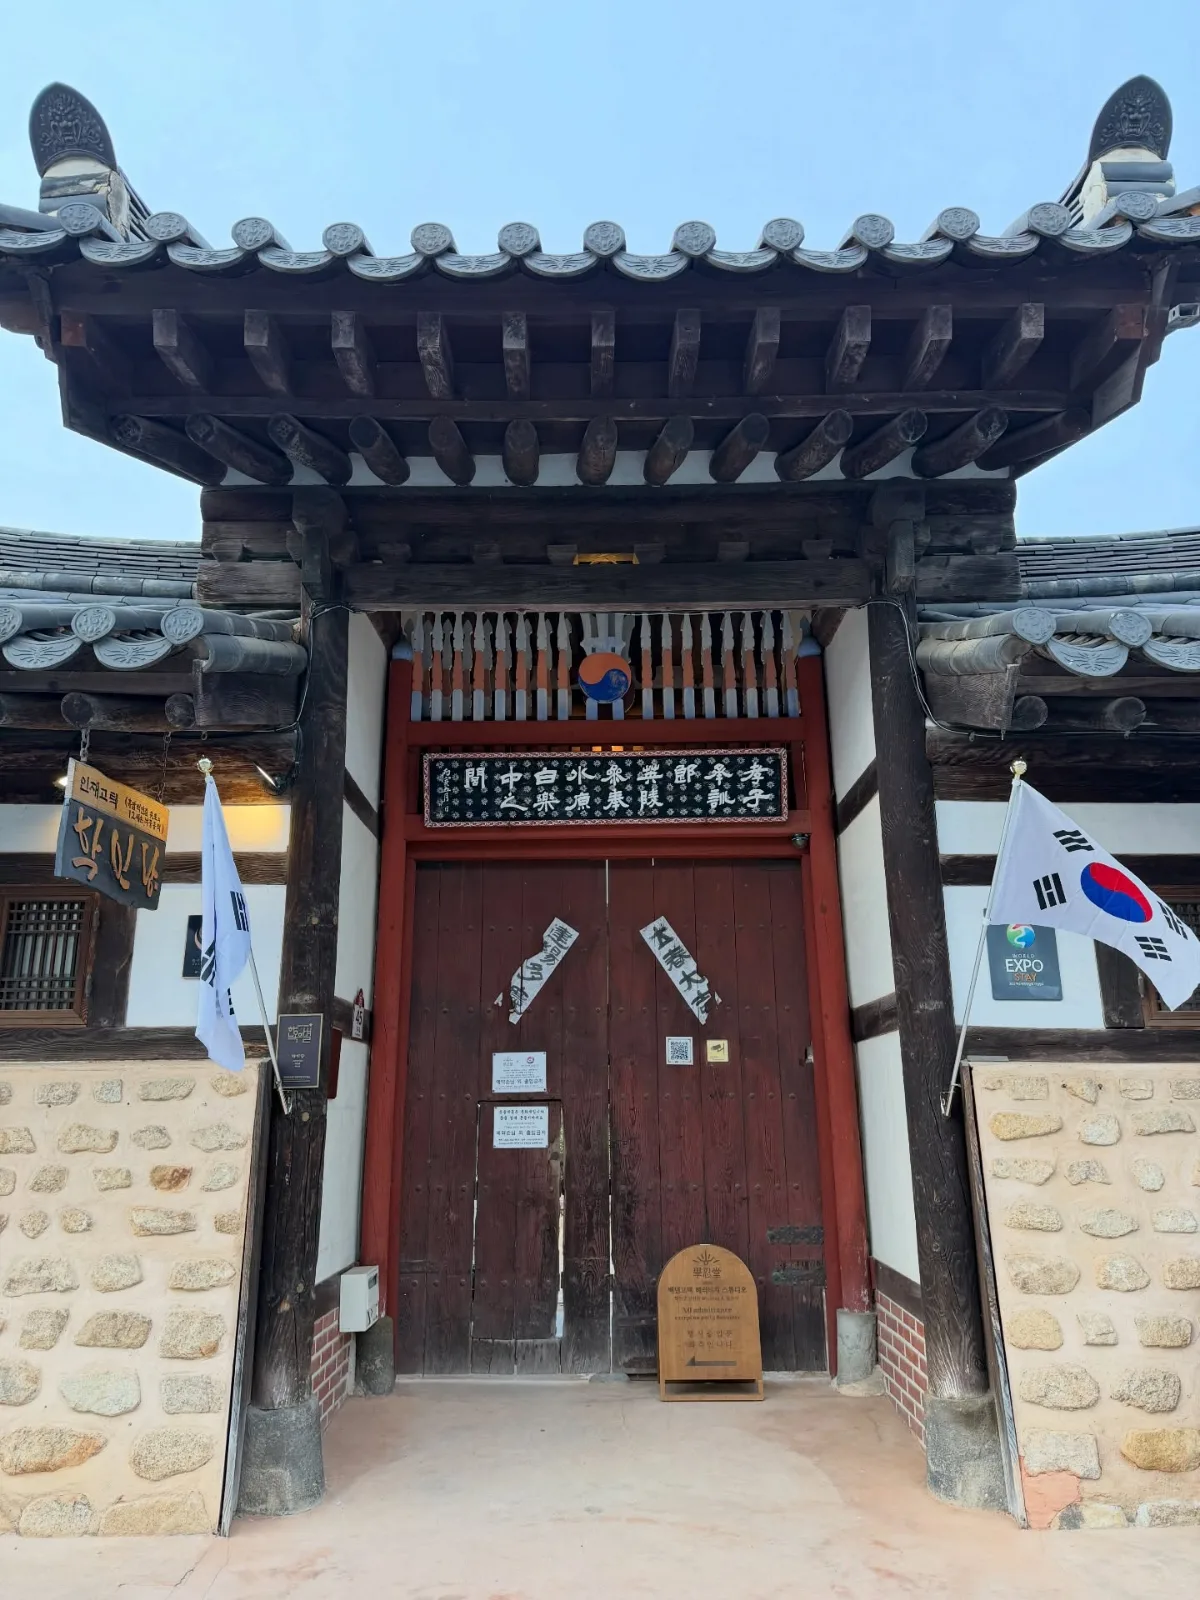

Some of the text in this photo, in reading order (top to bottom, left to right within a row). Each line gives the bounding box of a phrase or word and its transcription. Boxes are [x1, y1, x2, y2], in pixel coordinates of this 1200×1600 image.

[80, 776, 118, 810] 인재고택
[71, 806, 160, 898] 학인당
[1005, 958, 1044, 973] EXPO
[1014, 973, 1037, 982] STAY
